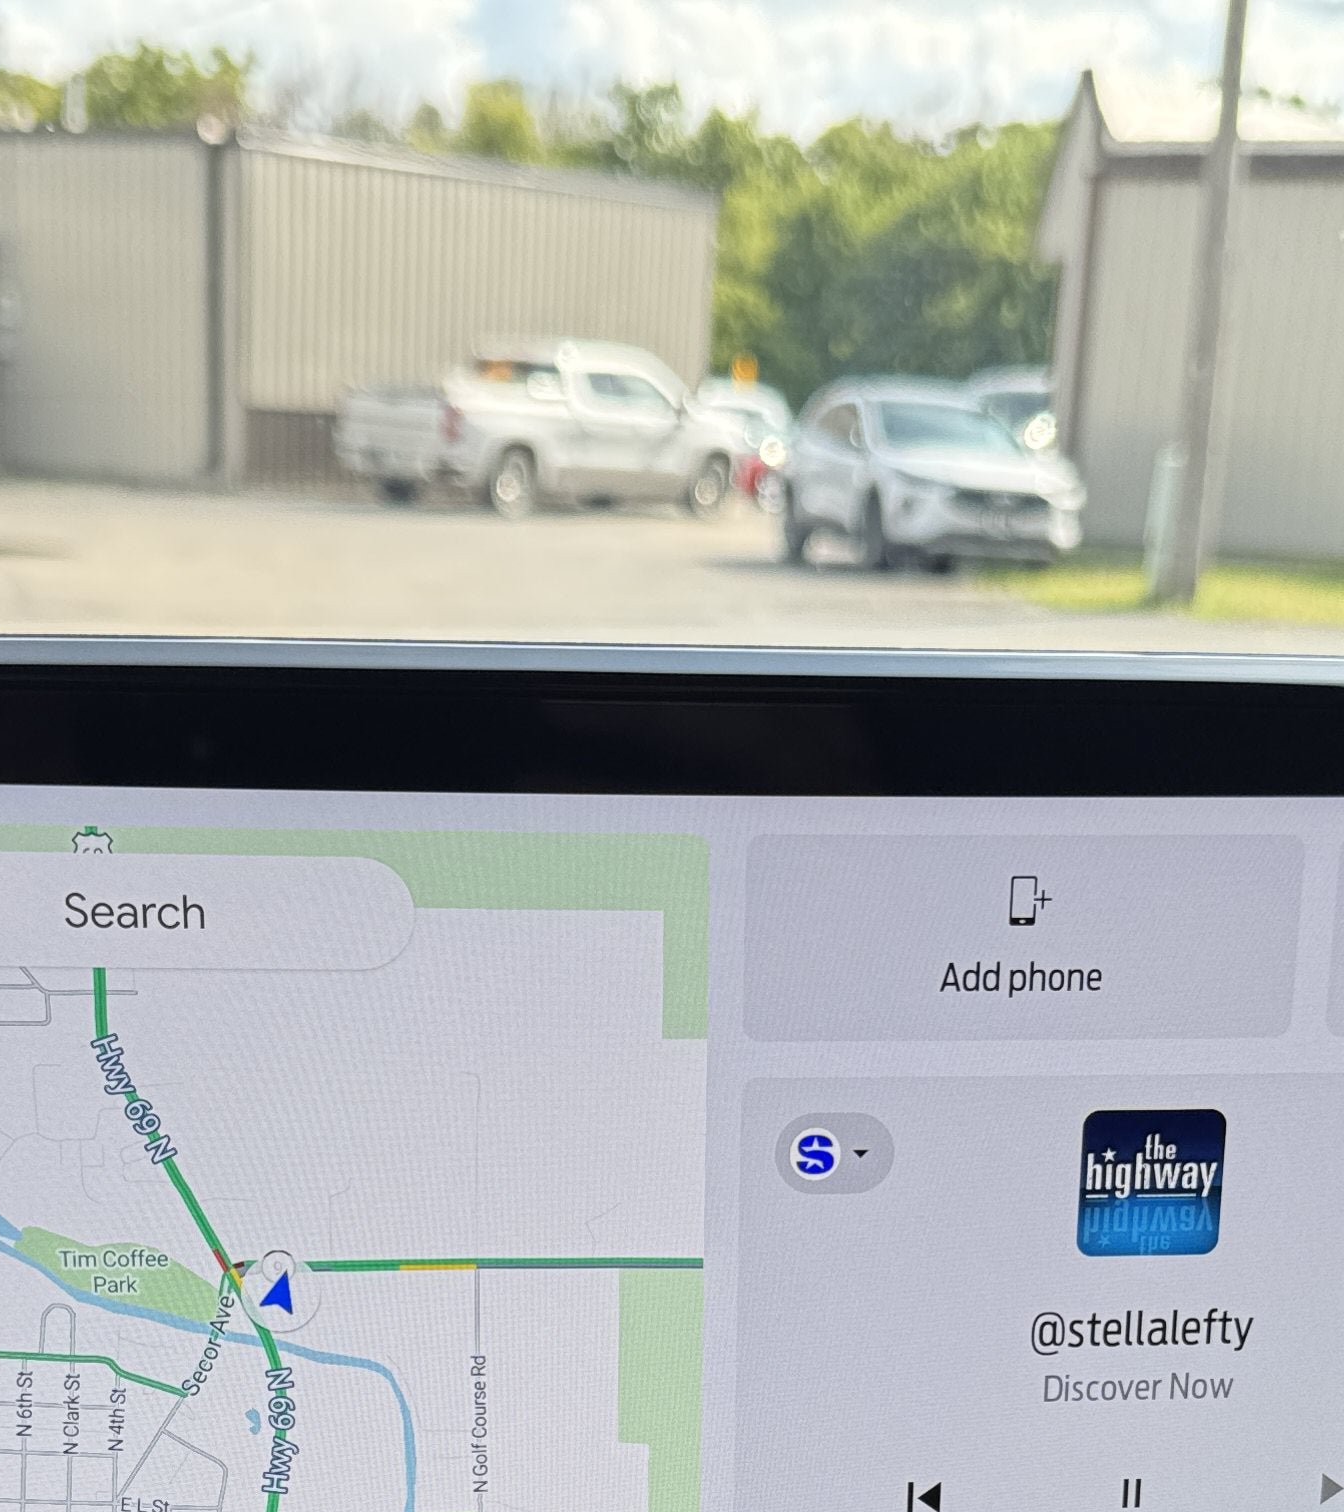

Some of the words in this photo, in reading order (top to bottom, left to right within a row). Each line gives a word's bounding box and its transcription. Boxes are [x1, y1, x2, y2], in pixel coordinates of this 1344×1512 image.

[65, 893, 205, 930] Search
[940, 962, 1003, 994] Add
[1008, 962, 1103, 1000] phone
[91, 1033, 136, 1095] Hwy
[125, 1099, 161, 1135] 69
[144, 1134, 178, 1164] N
[1145, 1133, 1177, 1160] the
[1085, 1151, 1218, 1199] highway
[59, 1250, 96, 1267] Tim
[103, 1249, 168, 1267] Coffee
[93, 1275, 137, 1293] Park
[182, 1337, 221, 1397] Secor
[210, 1295, 235, 1335] Ave
[1030, 1309, 1254, 1356] @stellalefty
[265, 1367, 294, 1391] N
[470, 1355, 486, 1376] Rd
[17, 1371, 33, 1388] St
[64, 1373, 81, 1391] St
[1043, 1373, 1162, 1403] Discover
[1169, 1371, 1233, 1400] Now
[16, 1393, 33, 1419] 6th
[110, 1388, 127, 1404] St
[63, 1395, 80, 1438] Clark
[109, 1408, 125, 1435] 4th
[268, 1395, 296, 1431] 69
[472, 1381, 487, 1439] Course
[16, 1424, 32, 1437] N
[63, 1442, 79, 1455] N
[108, 1439, 124, 1451] N
[262, 1436, 299, 1494] Hwy
[472, 1443, 488, 1477] Golf
[473, 1480, 488, 1492] N
[121, 1499, 131, 1512] E
[137, 1500, 146, 1512] L
